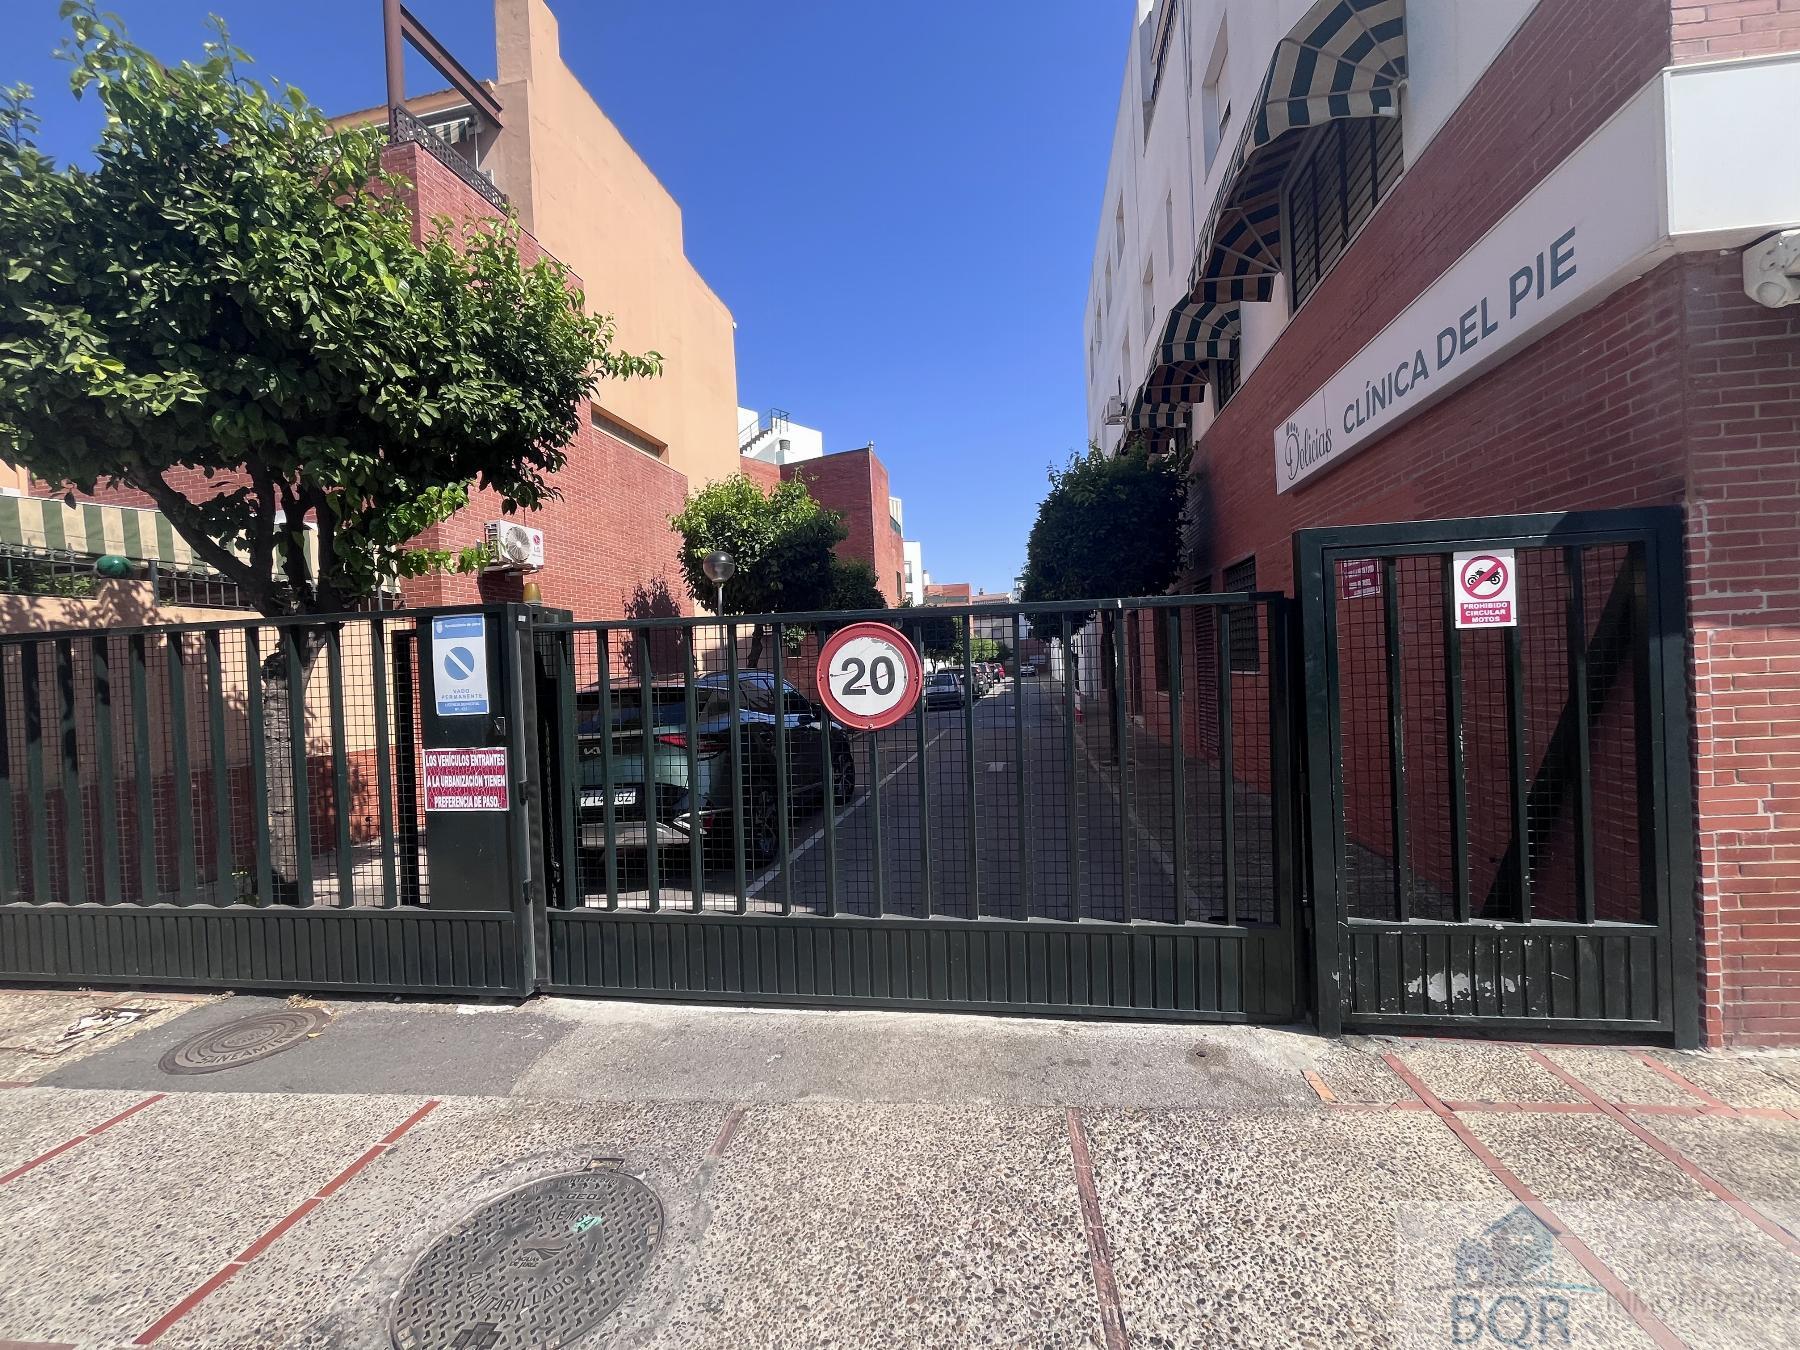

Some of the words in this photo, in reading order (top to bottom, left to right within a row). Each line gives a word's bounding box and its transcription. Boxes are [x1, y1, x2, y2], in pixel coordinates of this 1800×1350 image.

[1343, 349, 1429, 434] CLÍNICA
[1436, 297, 1498, 370] DEL
[1508, 226, 1577, 320] PIE
[1463, 602, 1508, 610] PROHIBIDO
[1465, 609, 1506, 617] CIRCULAR
[841, 655, 896, 695] 20
[425, 754, 437, 767] LOS
[437, 752, 470, 767] VEHÍCULOS
[470, 753, 505, 767] ENTRANTES
[427, 775, 432, 788] A
[432, 775, 440, 788] LA
[440, 772, 483, 788] URBANIZACIÓN
[483, 774, 506, 787] TIENEN
[434, 795, 473, 808] PREFERENCIA
[473, 795, 482, 808] DE
[482, 795, 500, 809] PASO.
[467, 1271, 575, 1312] ALCANTARILLADO
